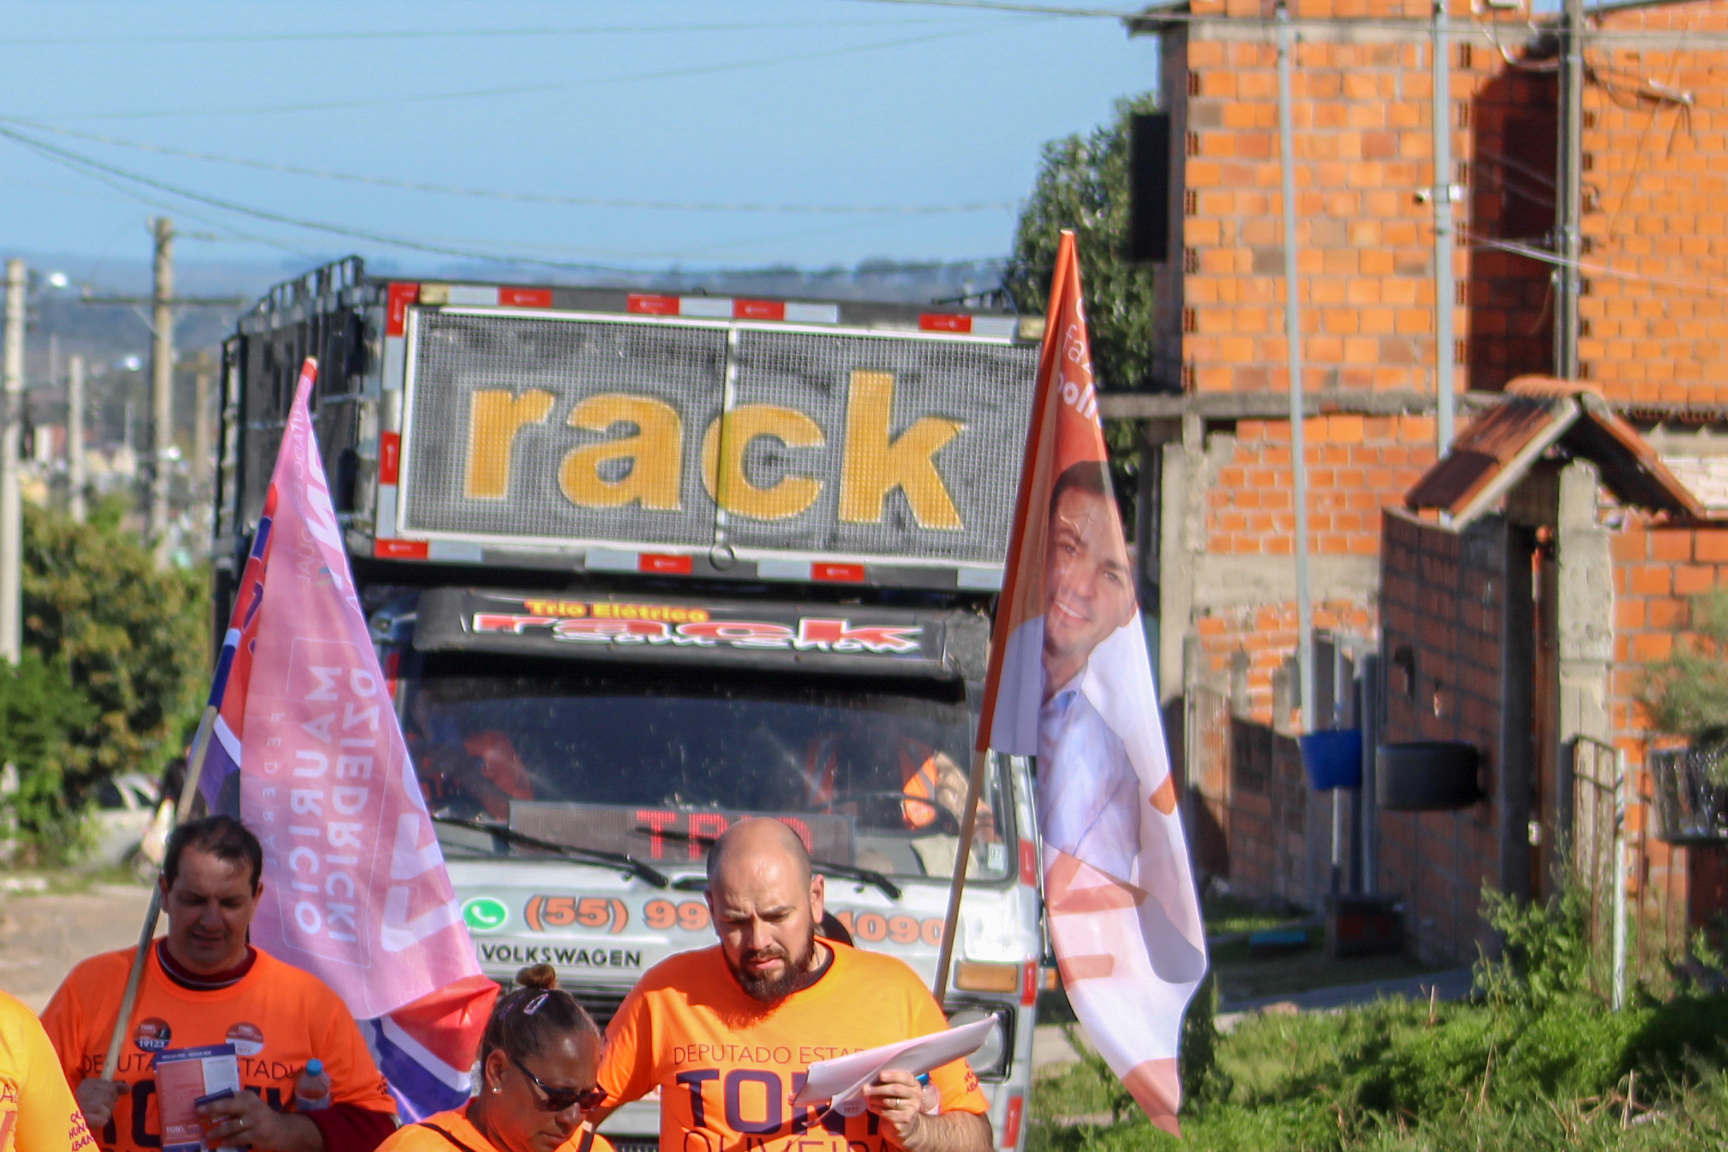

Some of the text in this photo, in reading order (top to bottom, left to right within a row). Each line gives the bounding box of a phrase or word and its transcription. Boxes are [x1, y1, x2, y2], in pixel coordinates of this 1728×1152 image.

[464, 369, 965, 530] rack
[525, 599, 710, 623] Trio Elétrico
[472, 612, 925, 645] rack
[524, 895, 629, 933] (55)
[482, 944, 641, 967] VOLKSWAGEN
[673, 1044, 791, 1065] DEPUTADO
